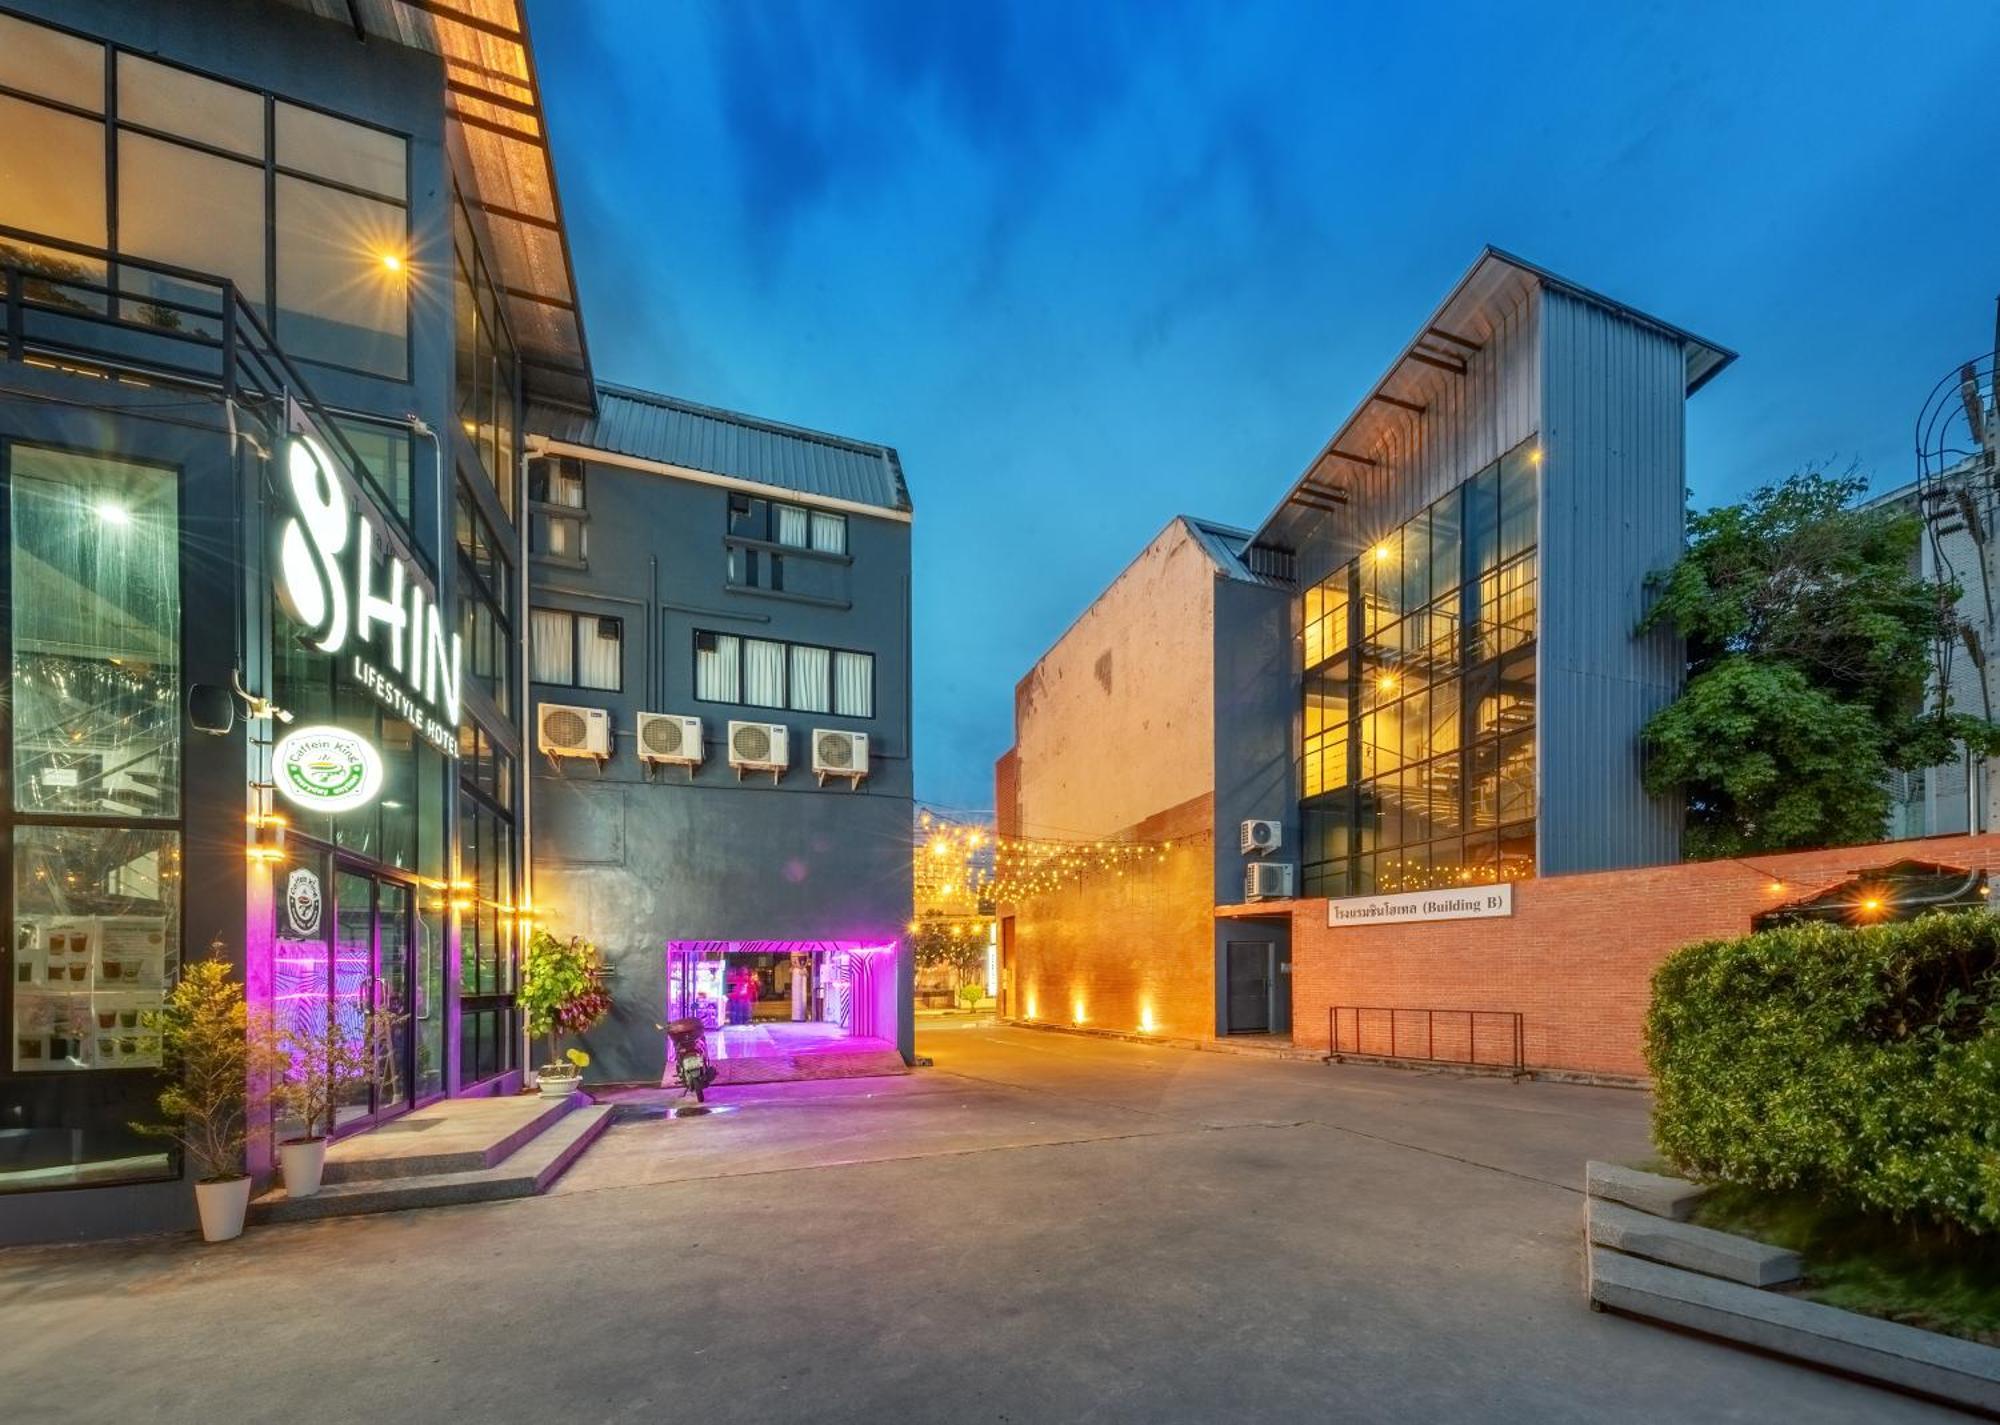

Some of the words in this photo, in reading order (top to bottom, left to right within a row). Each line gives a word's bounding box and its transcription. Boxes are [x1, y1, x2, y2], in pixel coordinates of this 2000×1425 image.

[281, 435, 462, 726] SHIN
[354, 655, 424, 733] LIFESTYLE
[426, 717, 461, 759] HOTEL
[334, 741, 360, 763] King
[1422, 898, 1481, 915] (Building
[1487, 895, 1503, 911] B)
